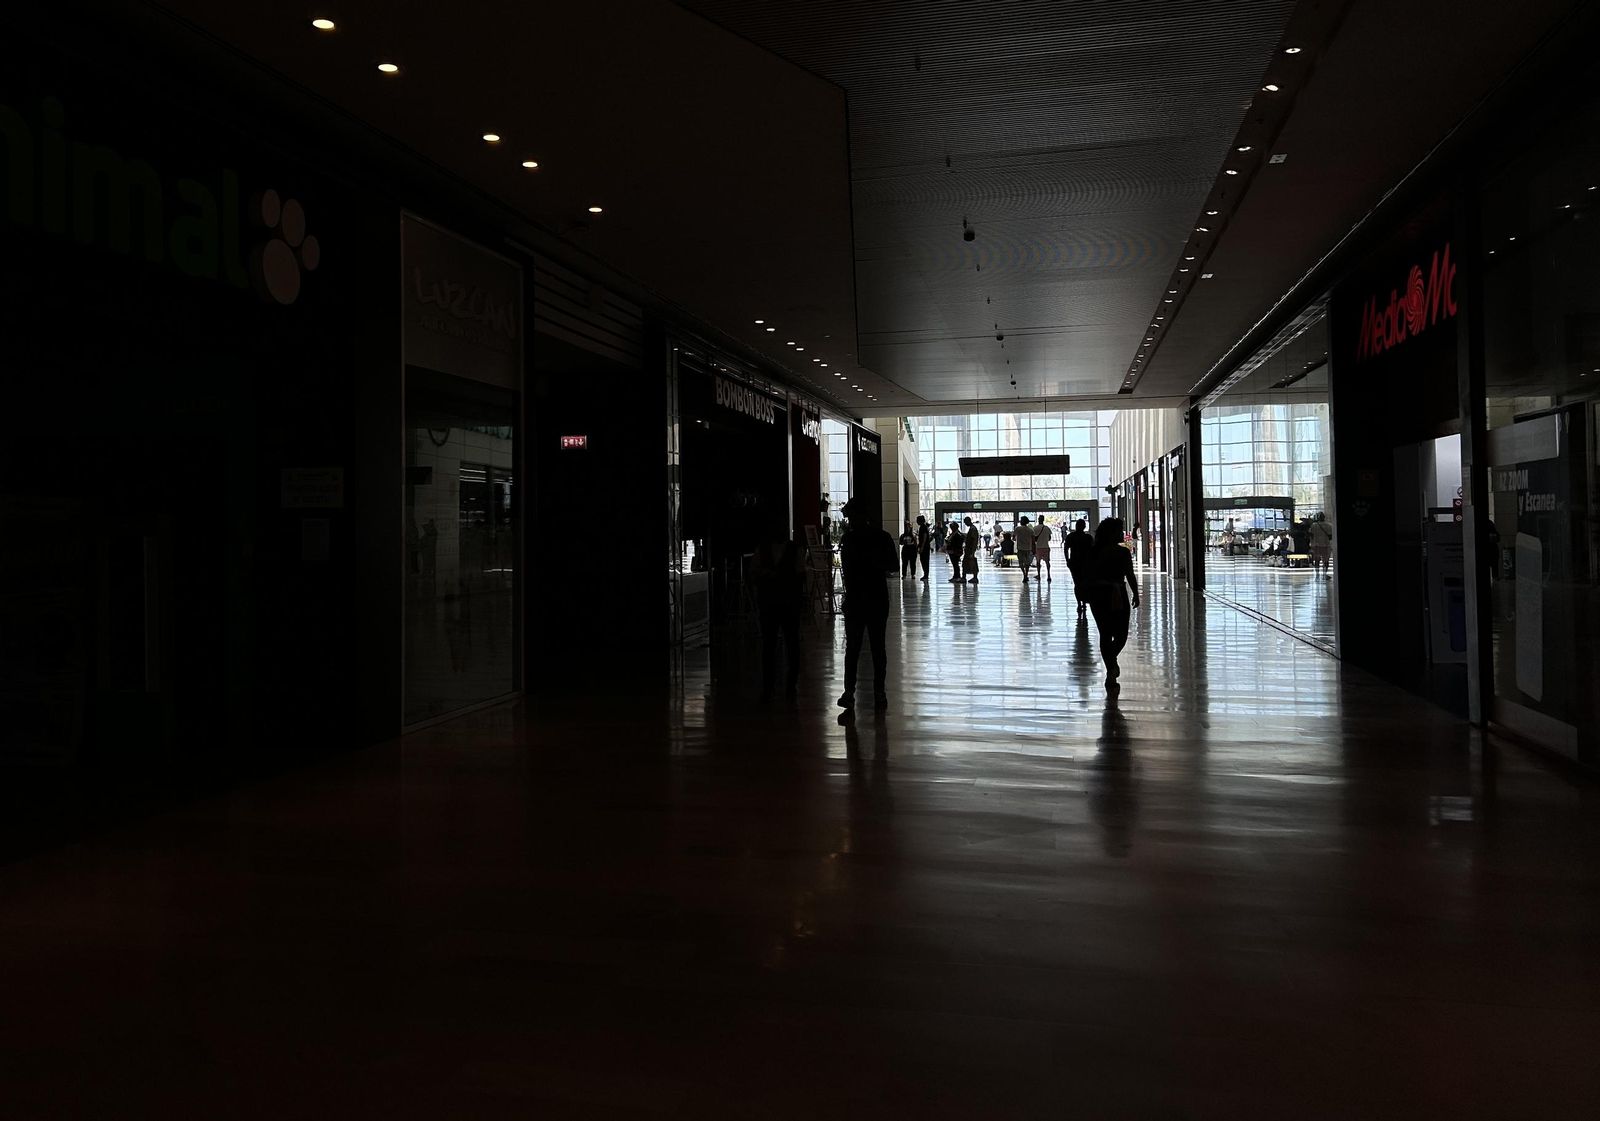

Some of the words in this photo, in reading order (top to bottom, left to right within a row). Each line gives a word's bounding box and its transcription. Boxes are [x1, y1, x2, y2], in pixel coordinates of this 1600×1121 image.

[714, 376, 755, 418] BOMBON
[755, 394, 775, 425] BOSS
[1525, 491, 1556, 512] Escanea
